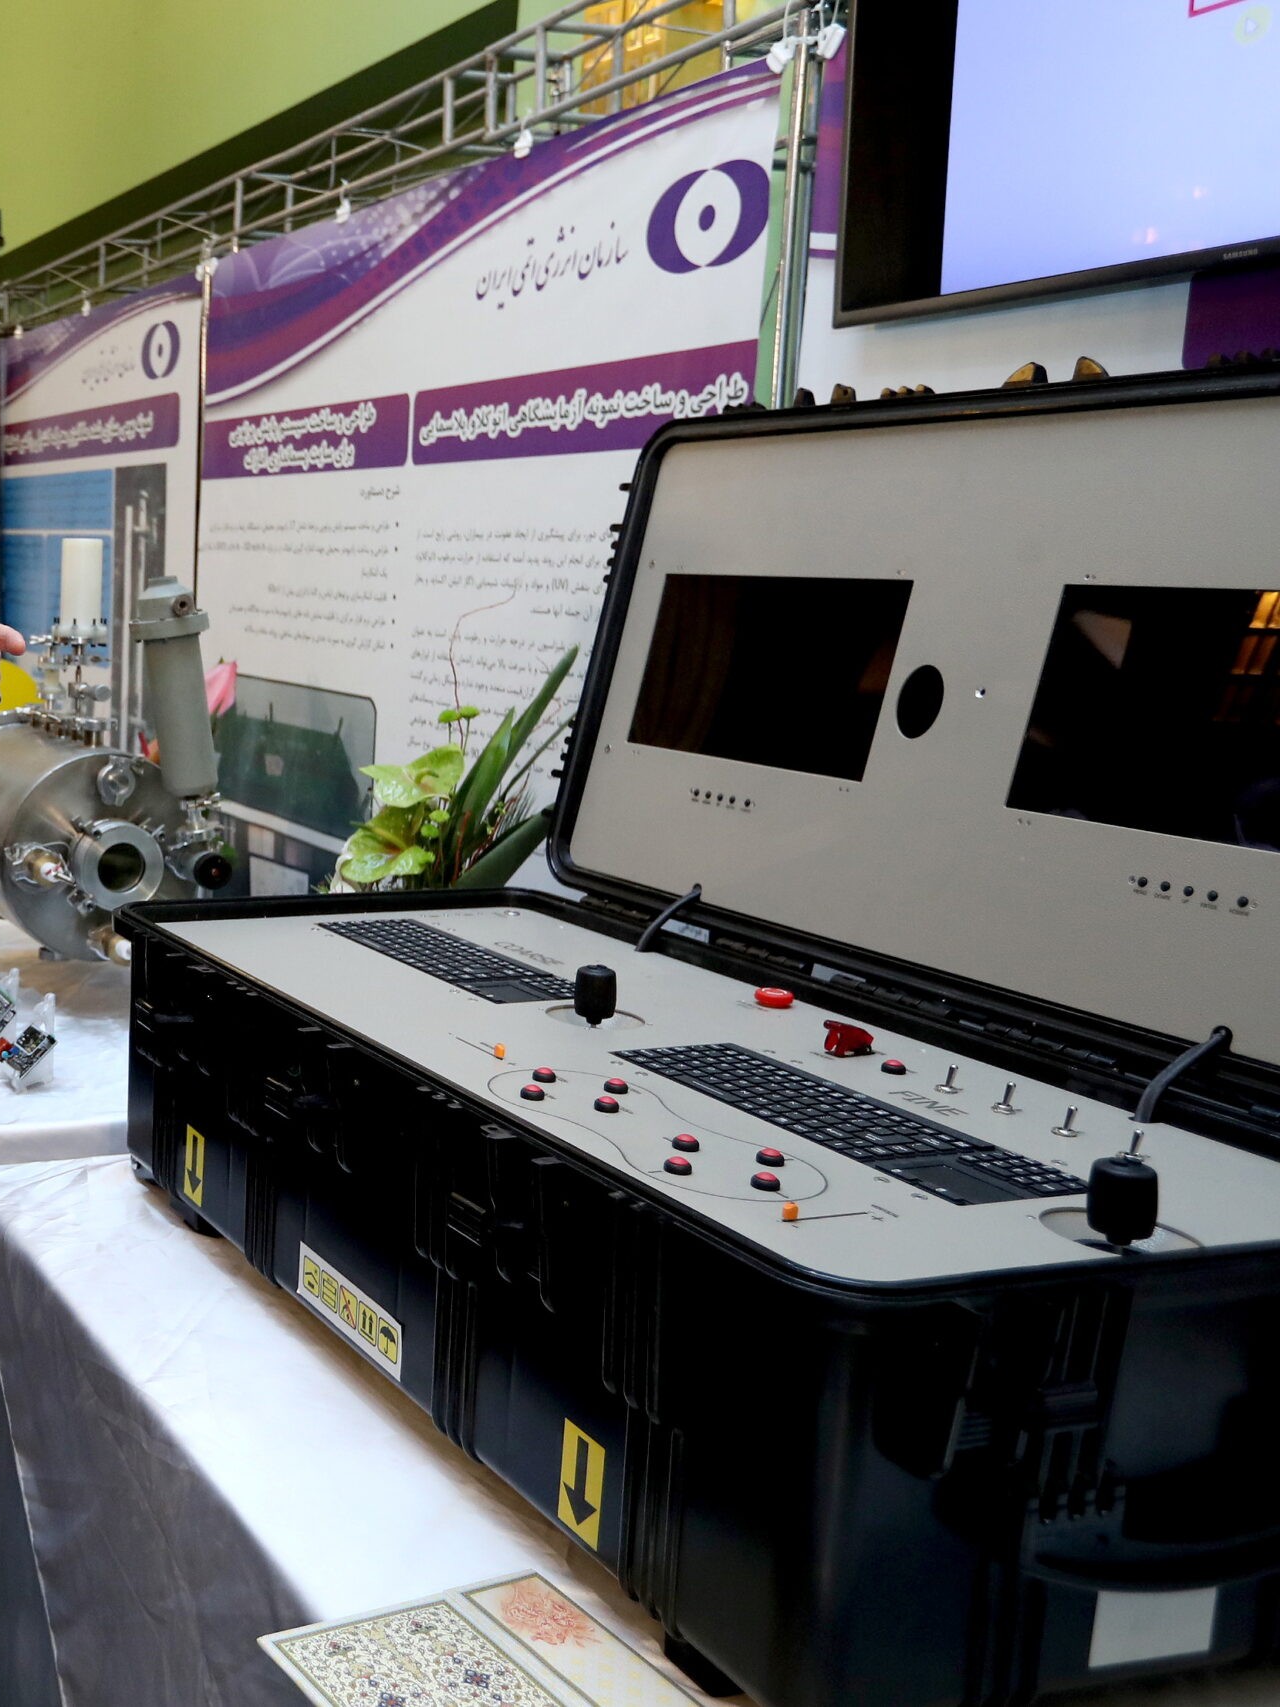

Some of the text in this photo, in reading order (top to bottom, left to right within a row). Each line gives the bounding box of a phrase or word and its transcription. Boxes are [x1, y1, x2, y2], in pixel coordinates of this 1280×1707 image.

[476, 221, 629, 310] سازمان انرژی اتمی ایران
[1223, 248, 1258, 260] SAMSUNG
[585, 389, 623, 428] نمونه
[622, 383, 673, 418] ساخت
[674, 390, 688, 418] و
[689, 372, 748, 417] طراحی
[308, 408, 336, 433] ساخت
[344, 402, 376, 435] طراحی
[508, 388, 587, 437] آزمایشگاهی
[279, 417, 308, 440] سیستم
[309, 440, 333, 468] سایت
[333, 437, 355, 467] برای
[888, 1090, 970, 1117] FINE
